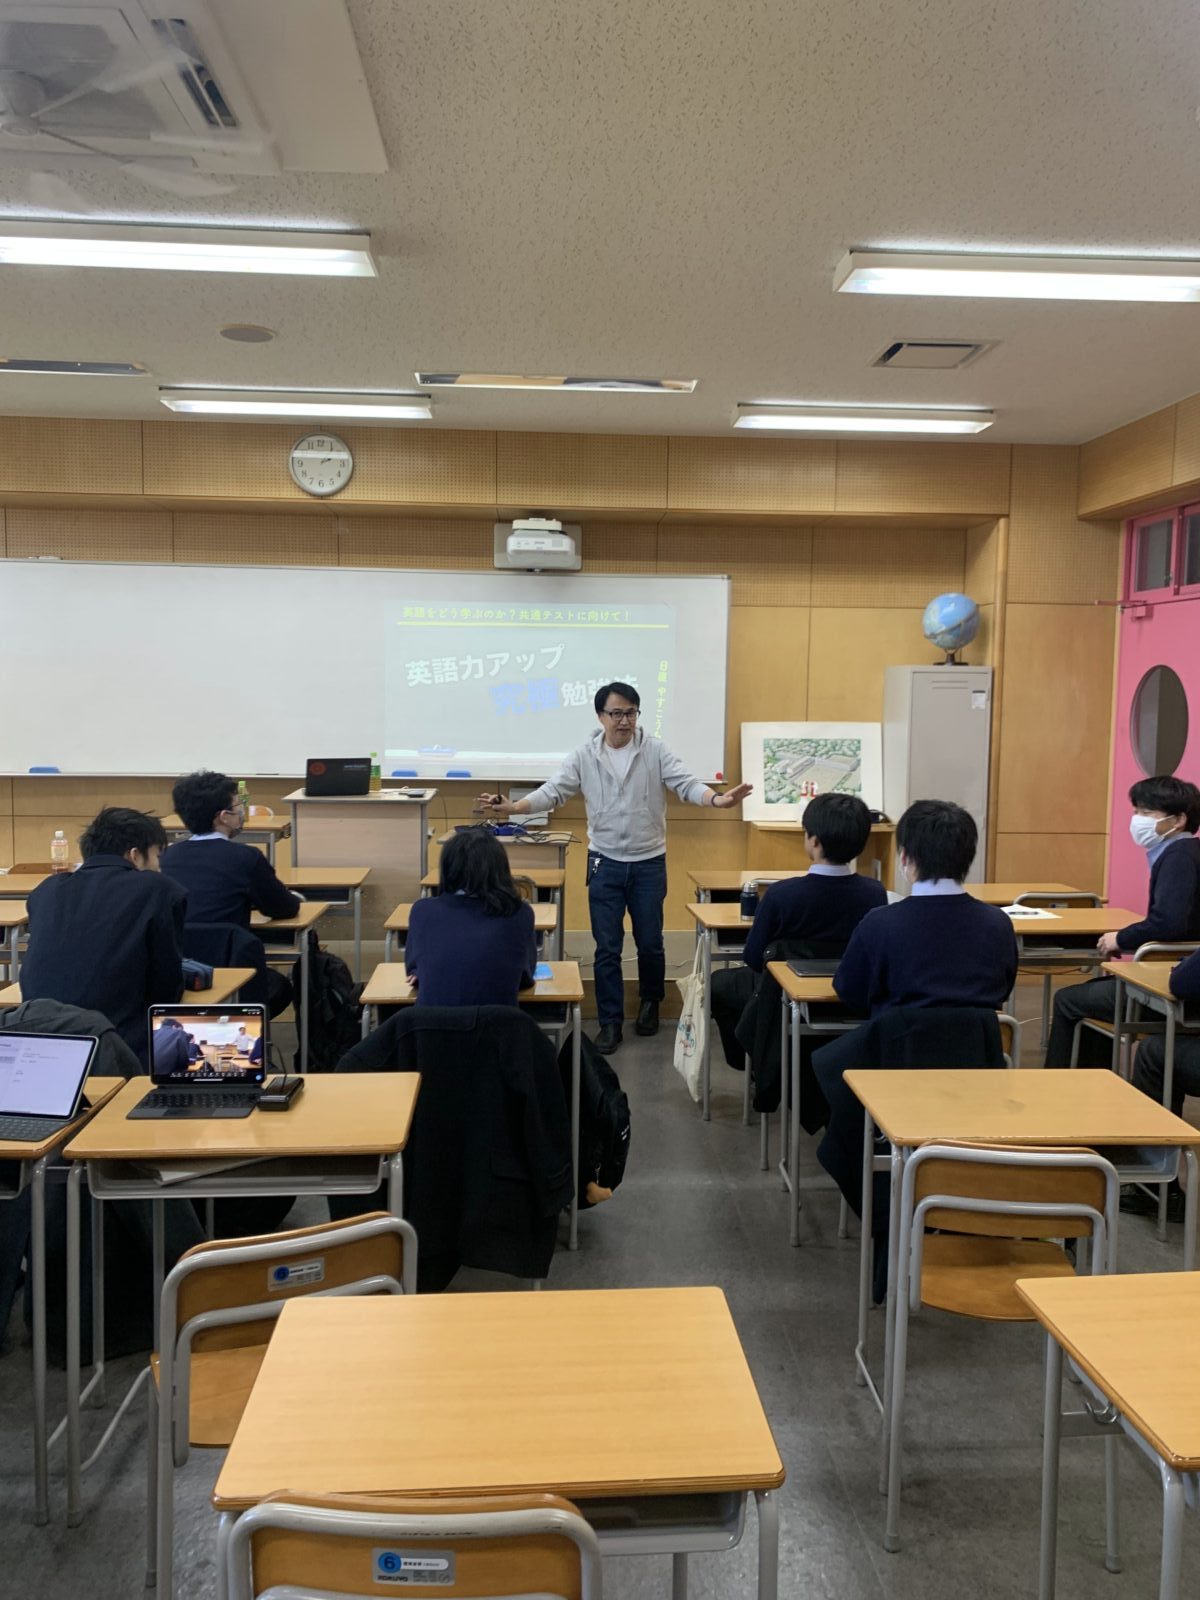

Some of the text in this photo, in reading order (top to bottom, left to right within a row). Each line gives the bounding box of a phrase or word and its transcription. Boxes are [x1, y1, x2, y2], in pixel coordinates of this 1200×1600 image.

[307, 441, 314, 450] 11
[316, 439, 325, 447] 12
[297, 459, 303, 468] 9
[336, 469, 341, 478] 4
[309, 477, 314, 485] 7
[318, 479, 325, 488] 6
[404, 643, 566, 687] 英語力アップ
[488, 674, 639, 717] 究極勉強
[383, 1555, 396, 1570] 6
